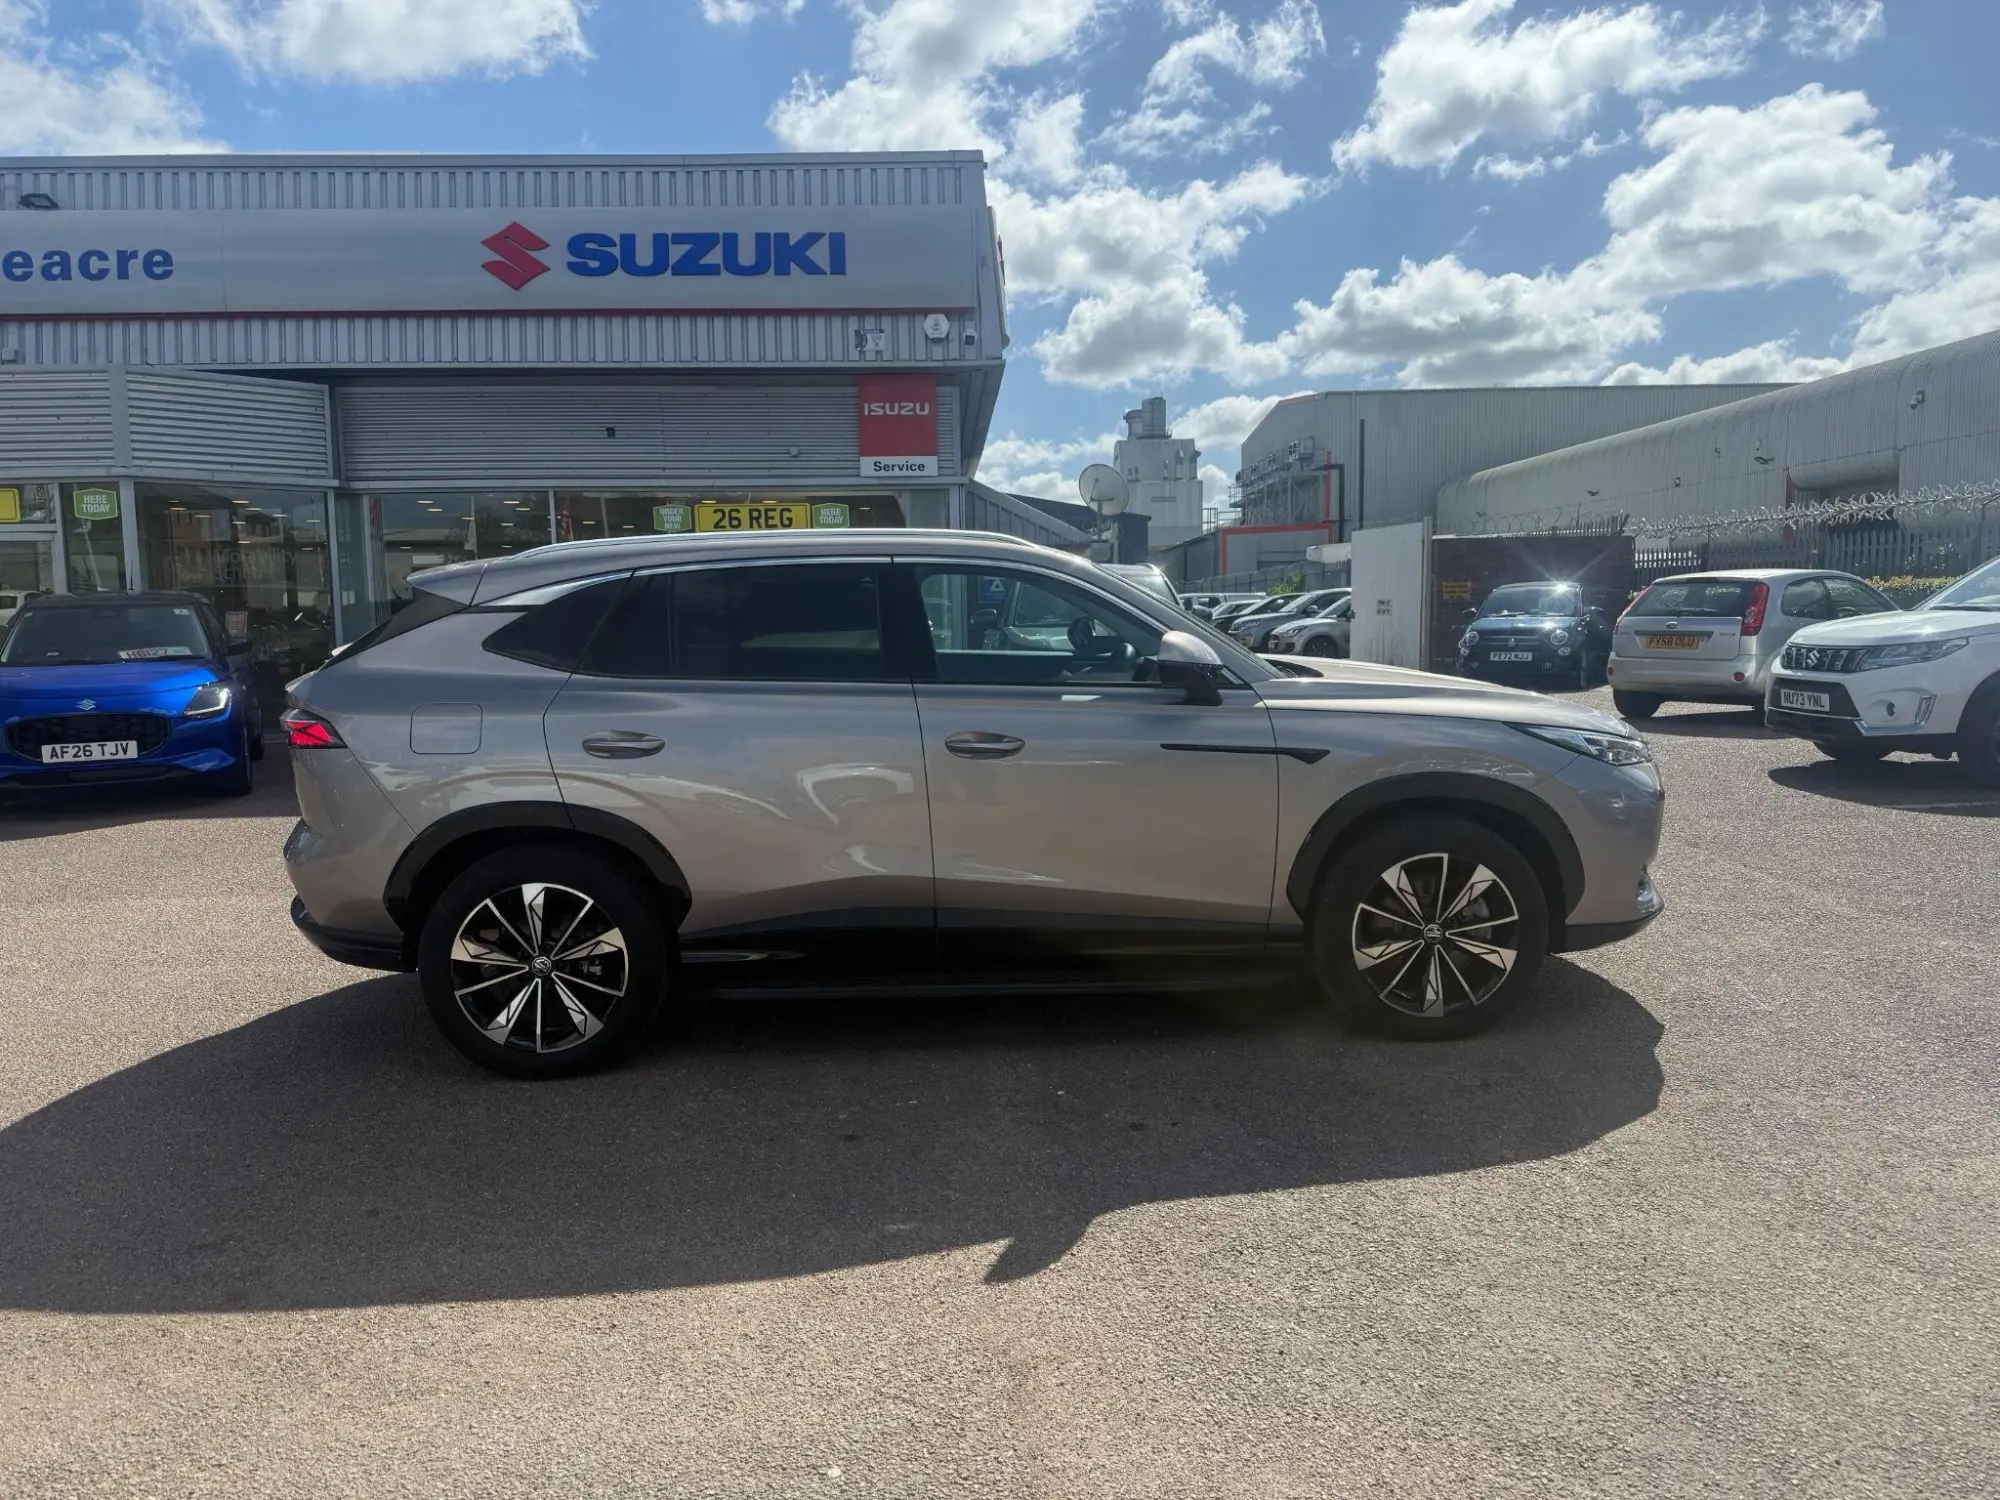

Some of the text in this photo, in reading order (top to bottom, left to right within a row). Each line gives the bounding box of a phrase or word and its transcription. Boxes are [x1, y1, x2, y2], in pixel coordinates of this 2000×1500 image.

[566, 231, 847, 277] SUZUKI
[2, 249, 175, 282] eacre
[864, 402, 930, 416] ISUZU
[873, 460, 926, 472] Service
[83, 494, 108, 504] HERE
[82, 504, 111, 513] TODAY
[660, 507, 684, 515] ORDER
[820, 508, 841, 516] HERE
[663, 515, 682, 523] YOUR
[712, 507, 793, 530] 26 REG
[818, 516, 844, 524] TODAY
[664, 522, 681, 530] NEW
[1783, 691, 1825, 708] NU73 YNL
[50, 742, 129, 760] AF26 TJV
